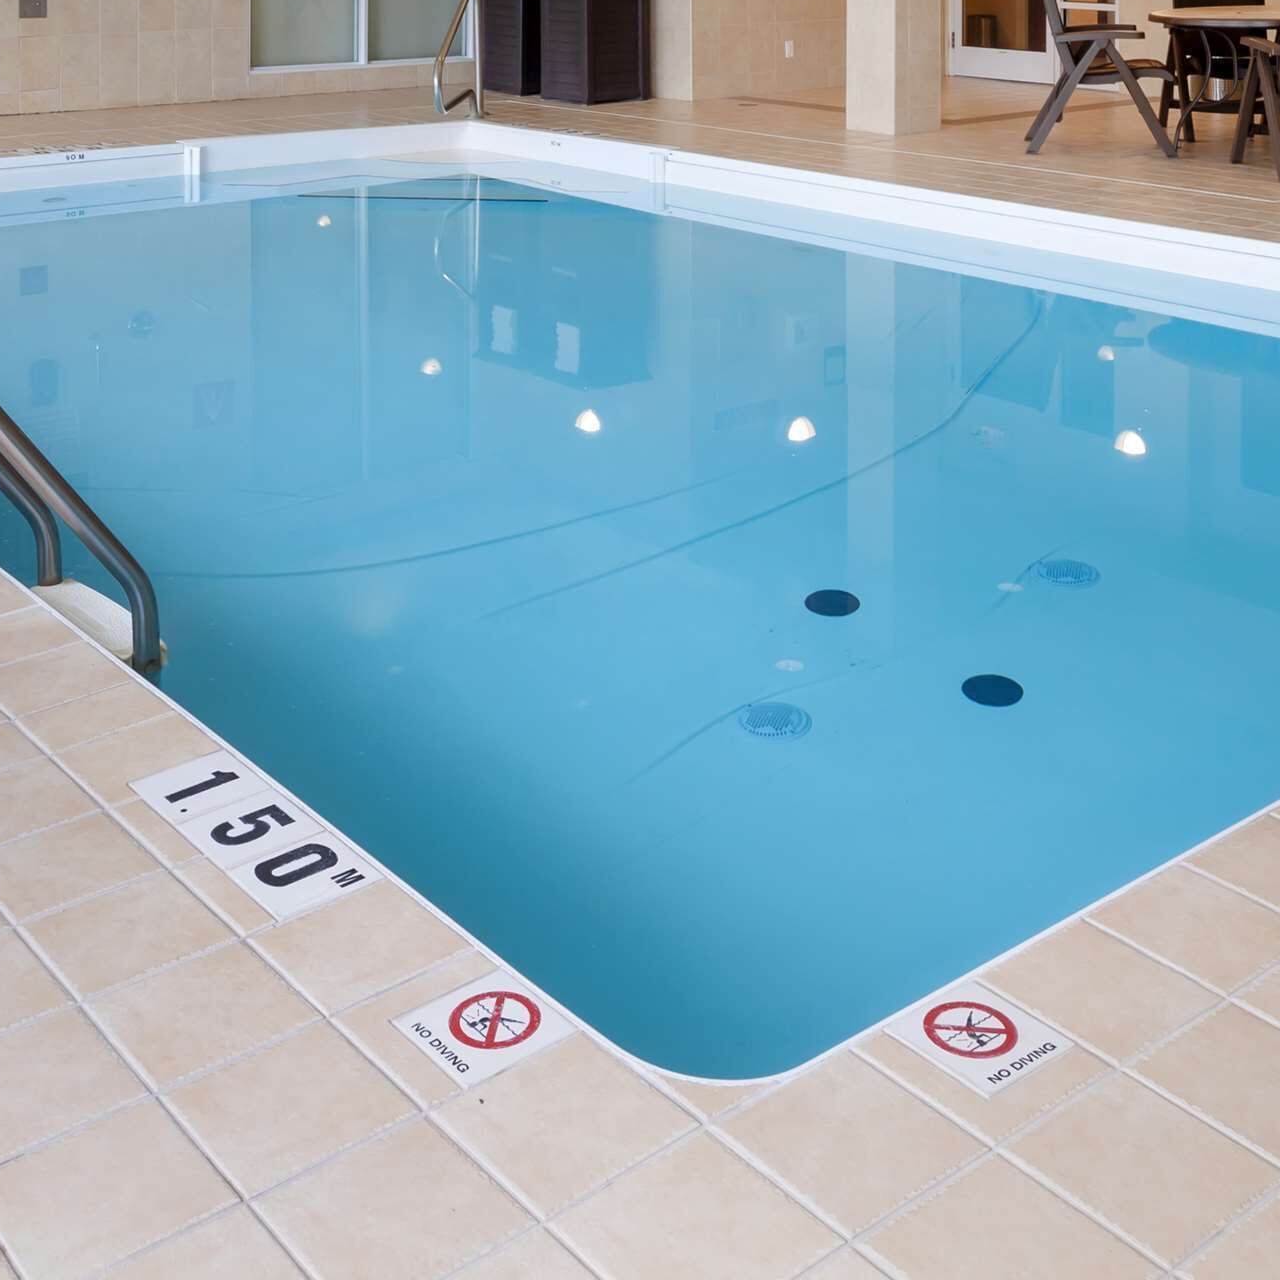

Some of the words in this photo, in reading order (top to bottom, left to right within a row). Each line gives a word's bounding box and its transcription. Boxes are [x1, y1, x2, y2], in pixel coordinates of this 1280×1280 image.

[411, 1022, 432, 1039] NO
[429, 1038, 470, 1074] DIVING
[987, 1068, 1011, 1085] NO
[1010, 1042, 1057, 1071] DIVING
